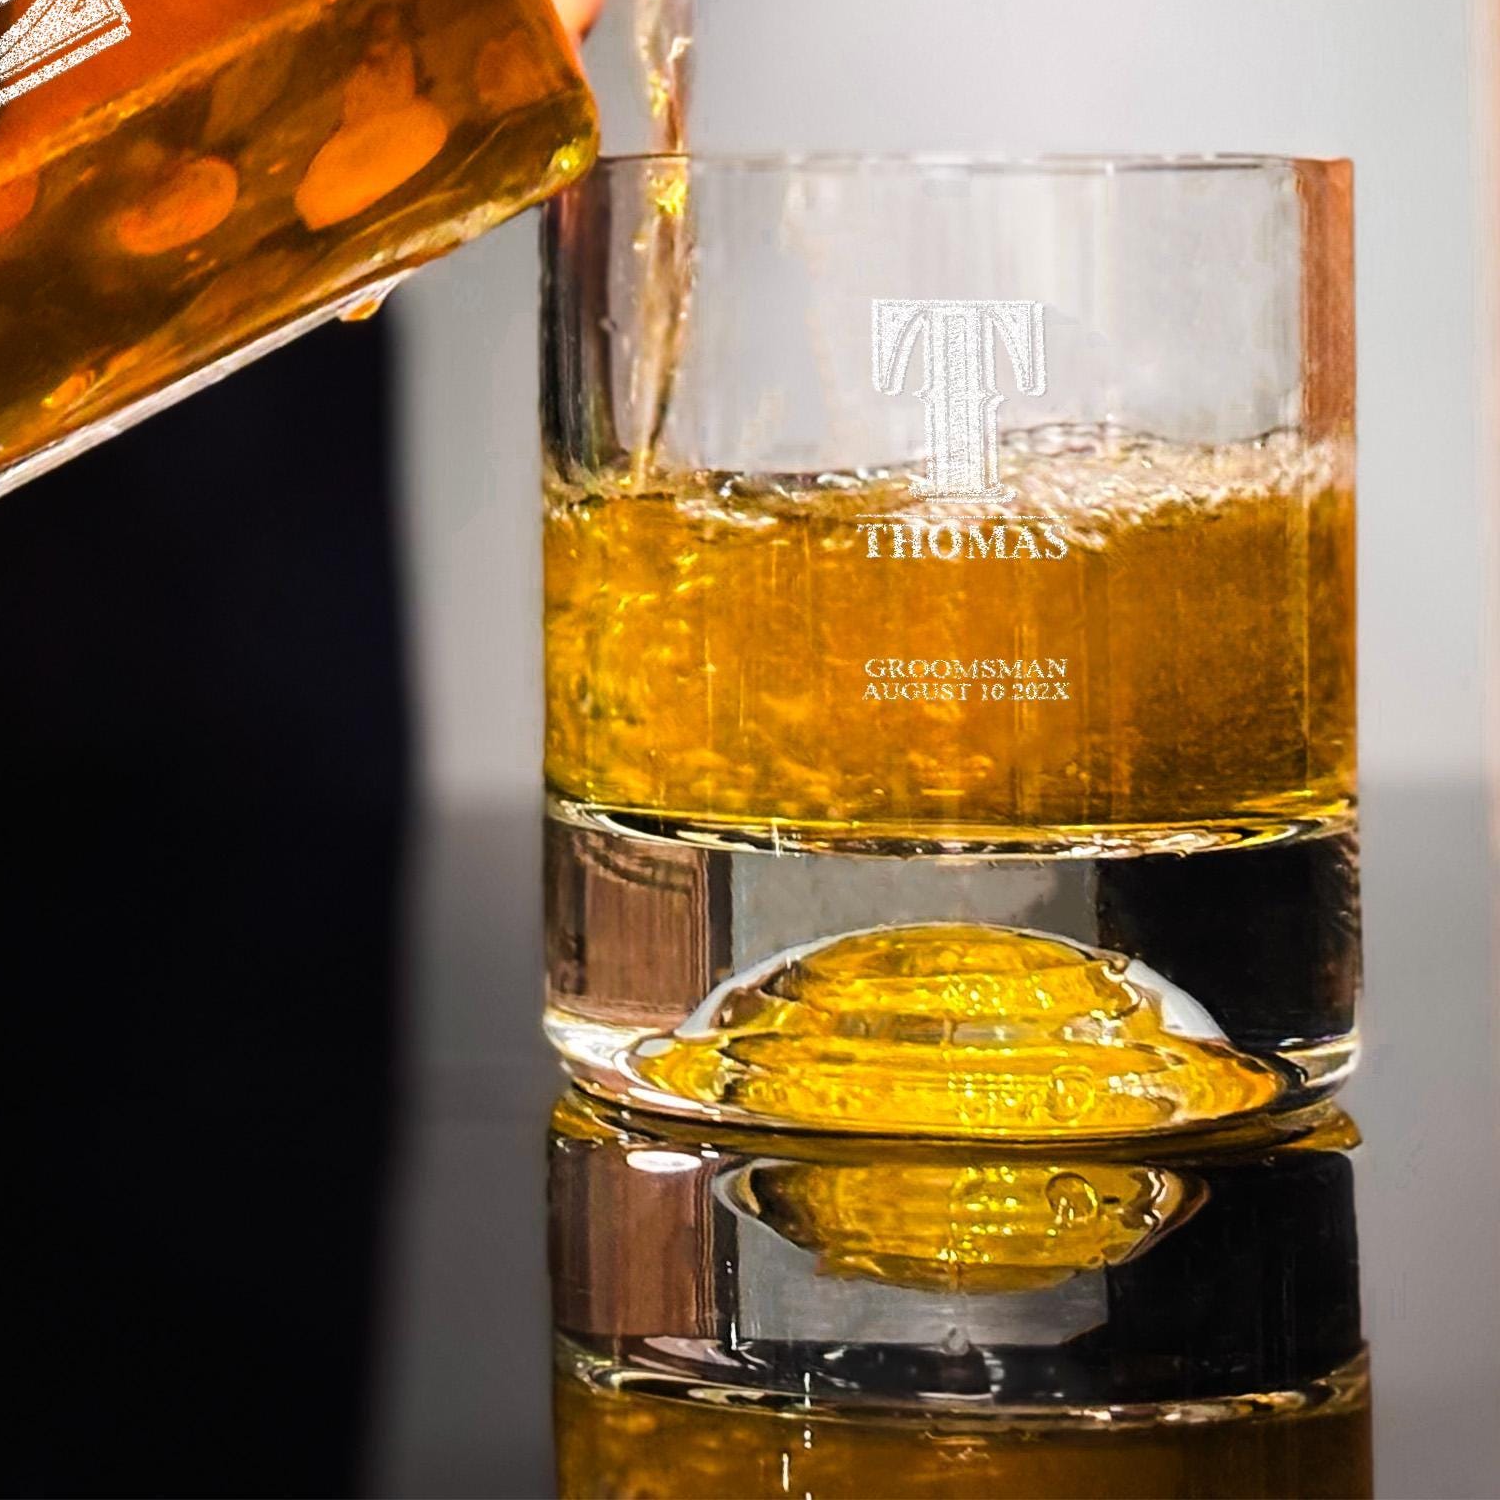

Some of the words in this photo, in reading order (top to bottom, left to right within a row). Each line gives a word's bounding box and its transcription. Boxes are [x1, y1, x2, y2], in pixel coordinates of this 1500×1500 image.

[871, 298, 1046, 504] T
[856, 521, 1070, 562] THOMAS
[864, 657, 1069, 679] GROOMSMAN
[862, 682, 971, 701] AUGUST
